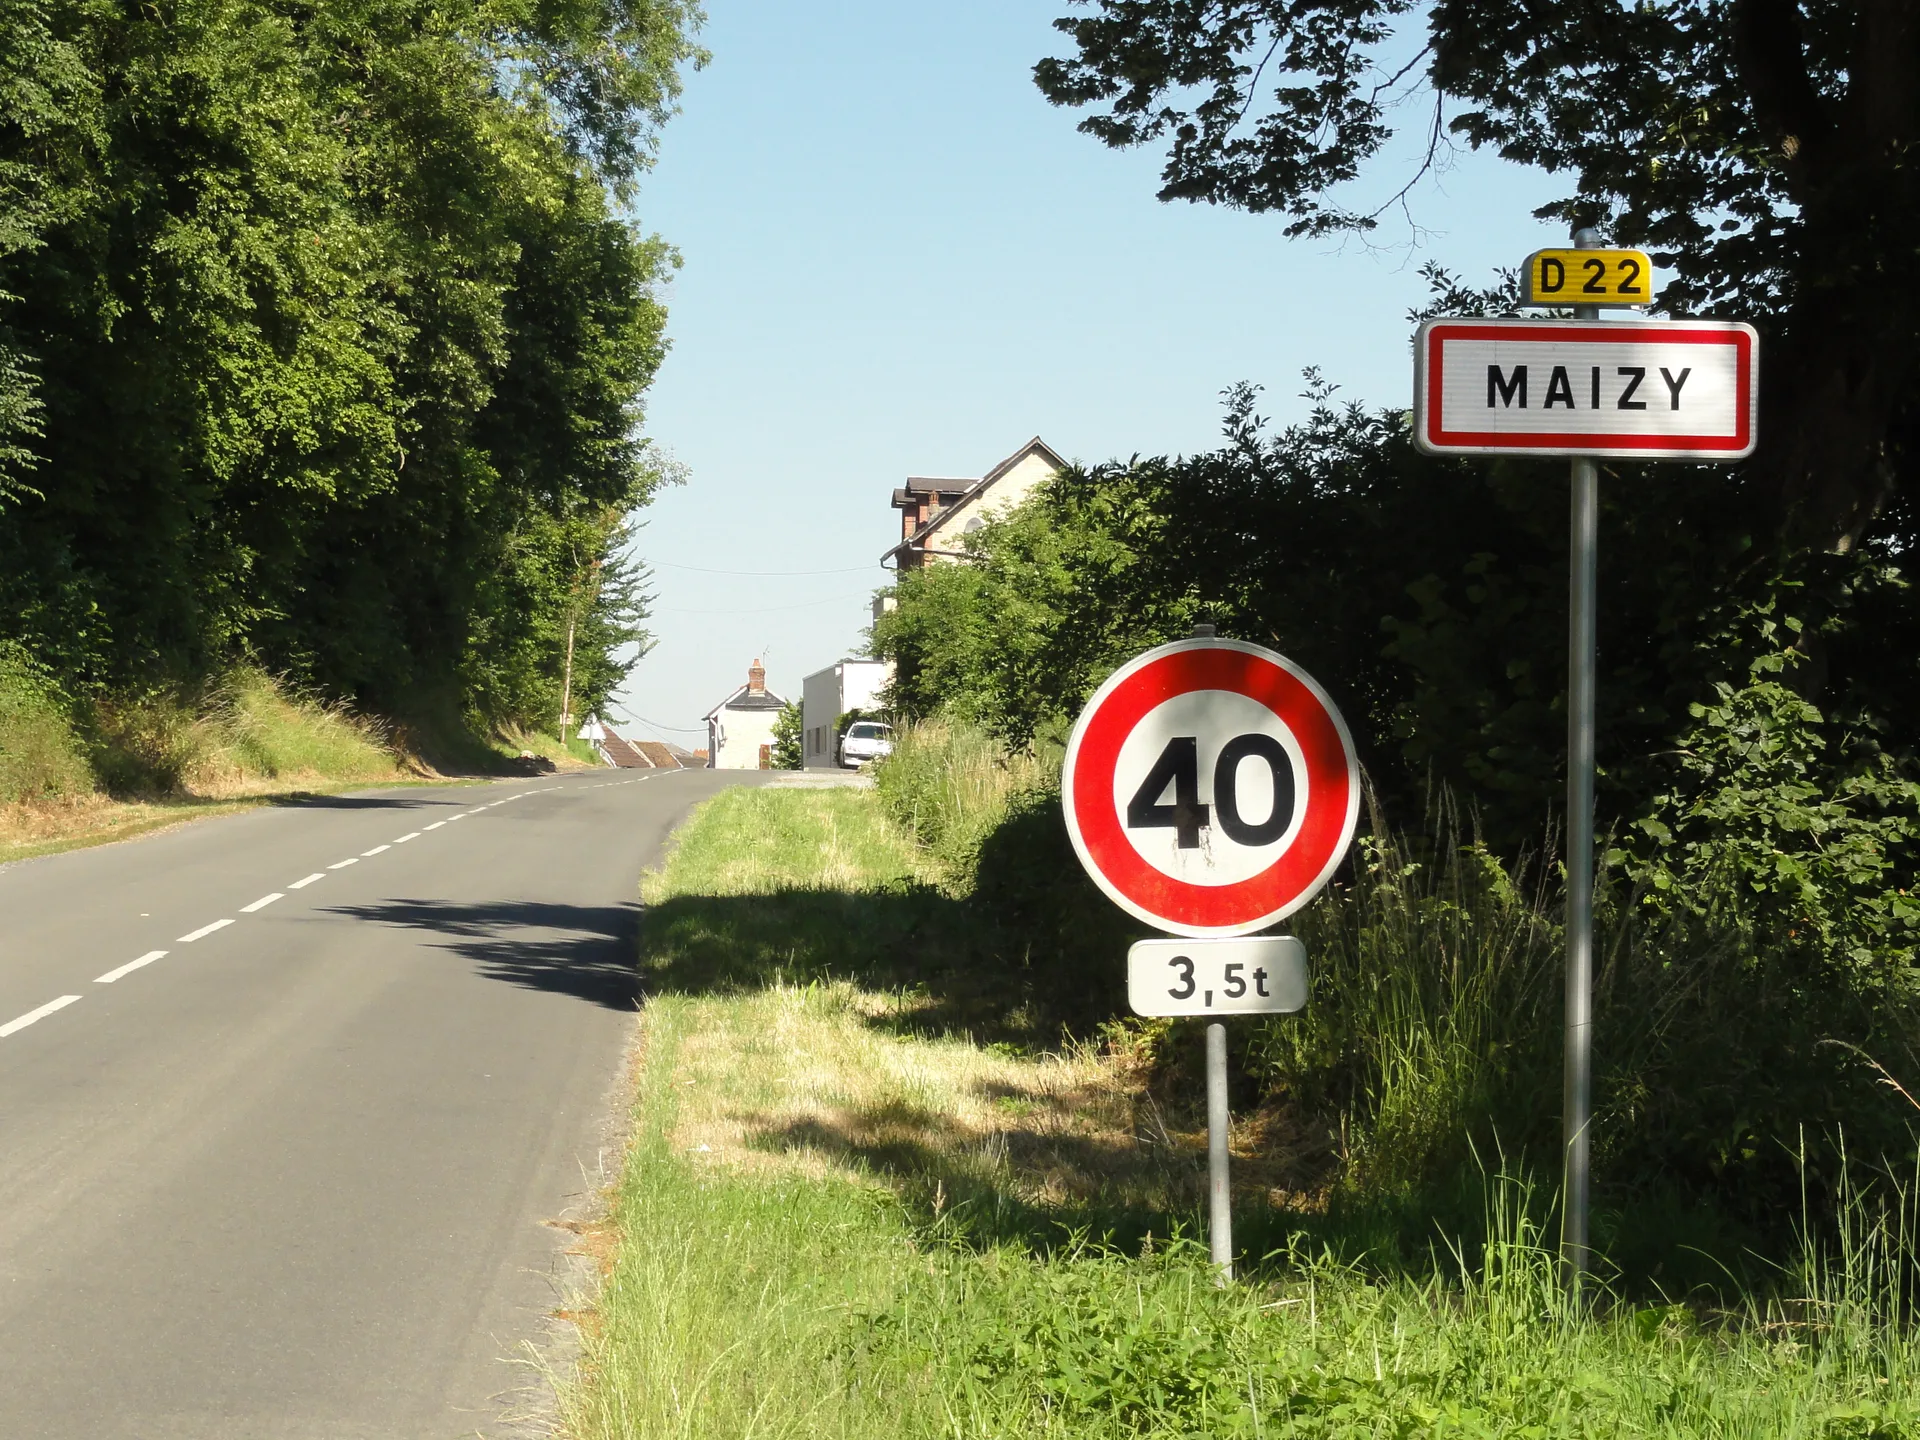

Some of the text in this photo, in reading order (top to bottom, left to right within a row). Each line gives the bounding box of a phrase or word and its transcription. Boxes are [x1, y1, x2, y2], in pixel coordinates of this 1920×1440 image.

[1541, 258, 1641, 294] D 22
[1487, 365, 1692, 410] MAIZY
[1127, 733, 1295, 849] 40
